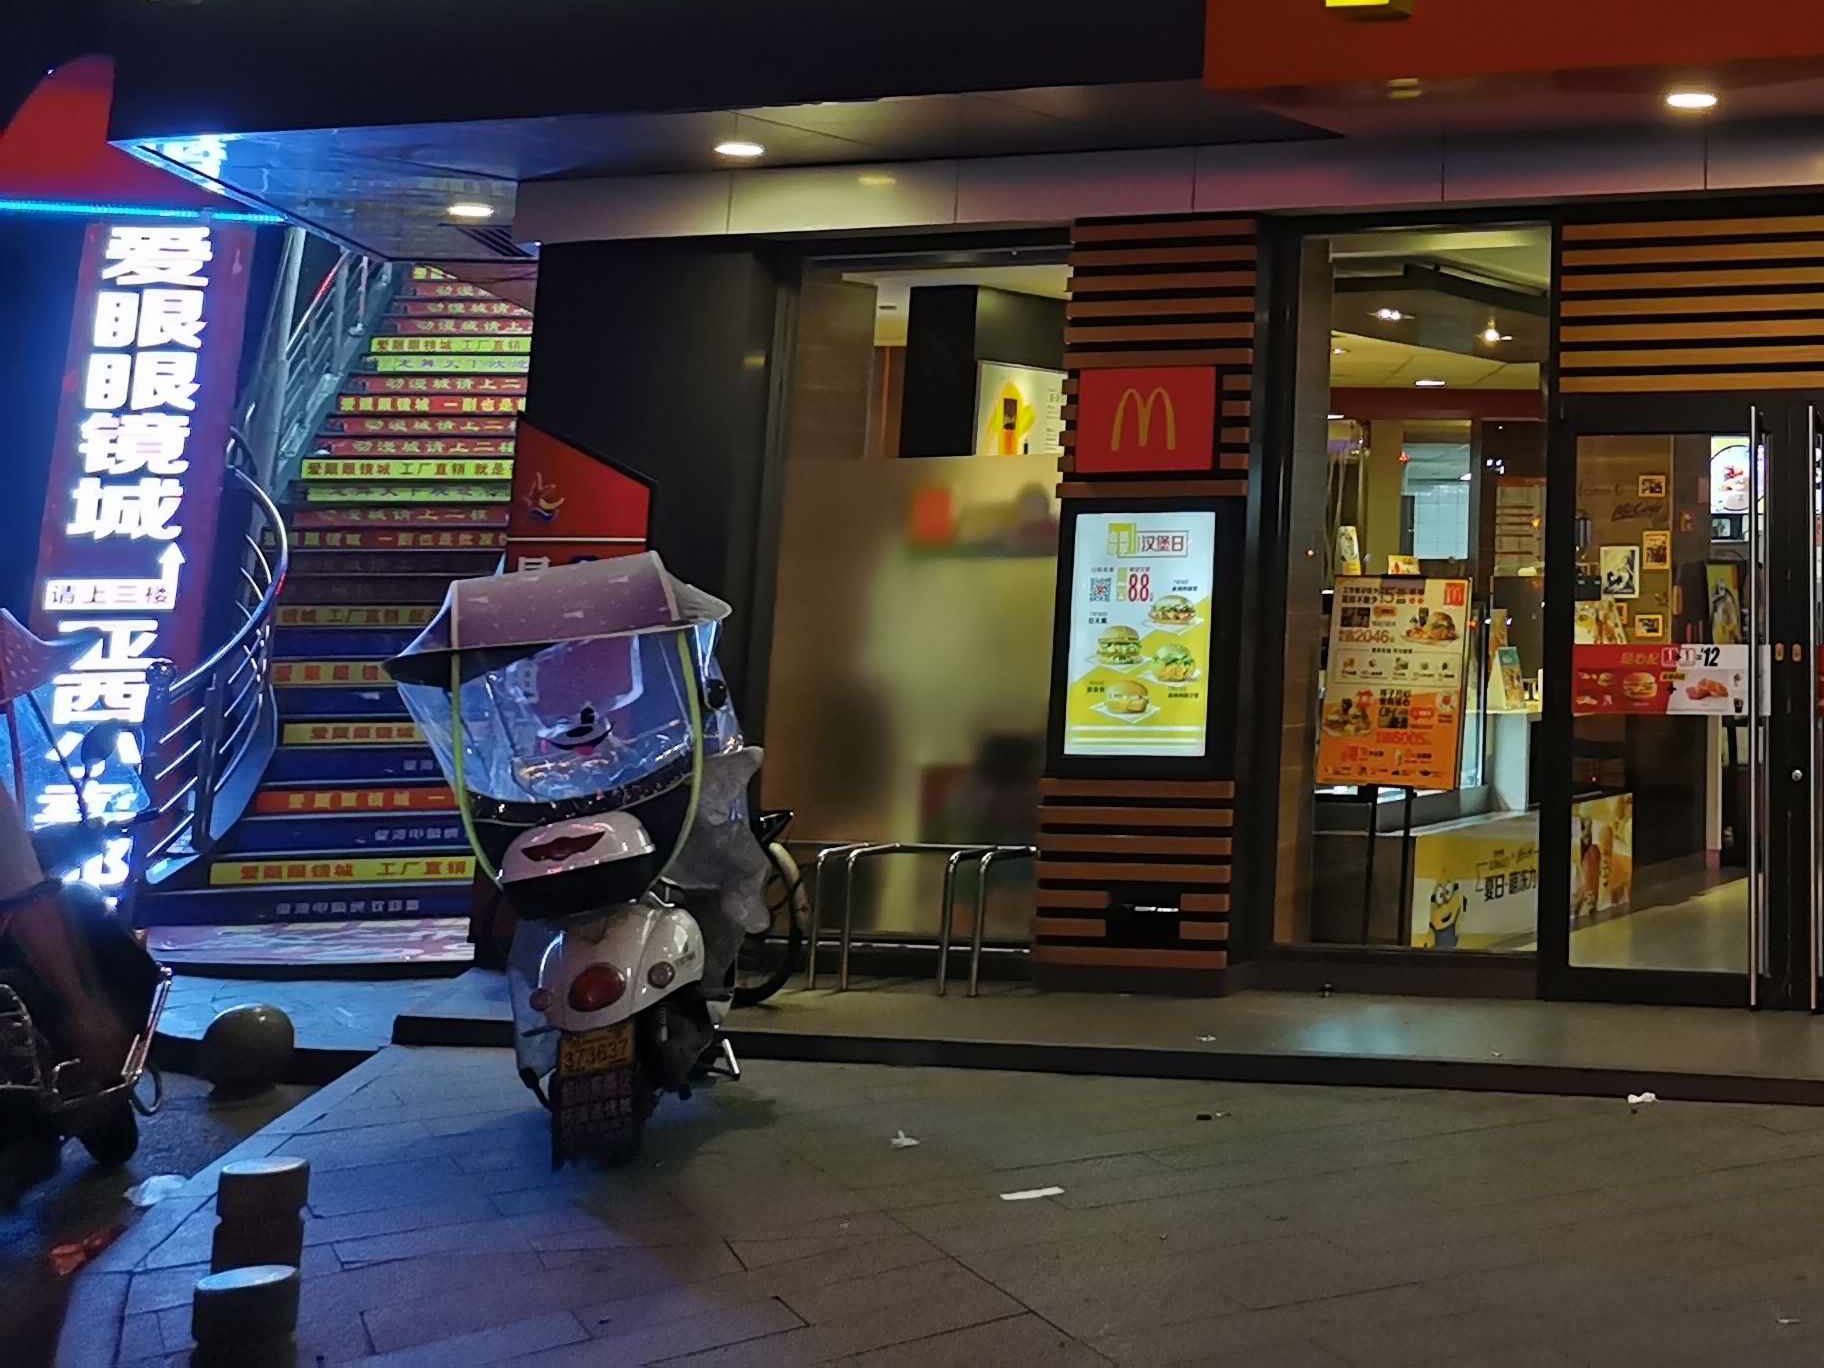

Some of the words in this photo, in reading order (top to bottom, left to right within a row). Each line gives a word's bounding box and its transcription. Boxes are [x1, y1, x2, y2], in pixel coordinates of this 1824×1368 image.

[66, 226, 213, 541] 爱眼眼镜城
[1140, 535, 1184, 552] 汉堡日
[52, 583, 169, 605] 请上三楼
